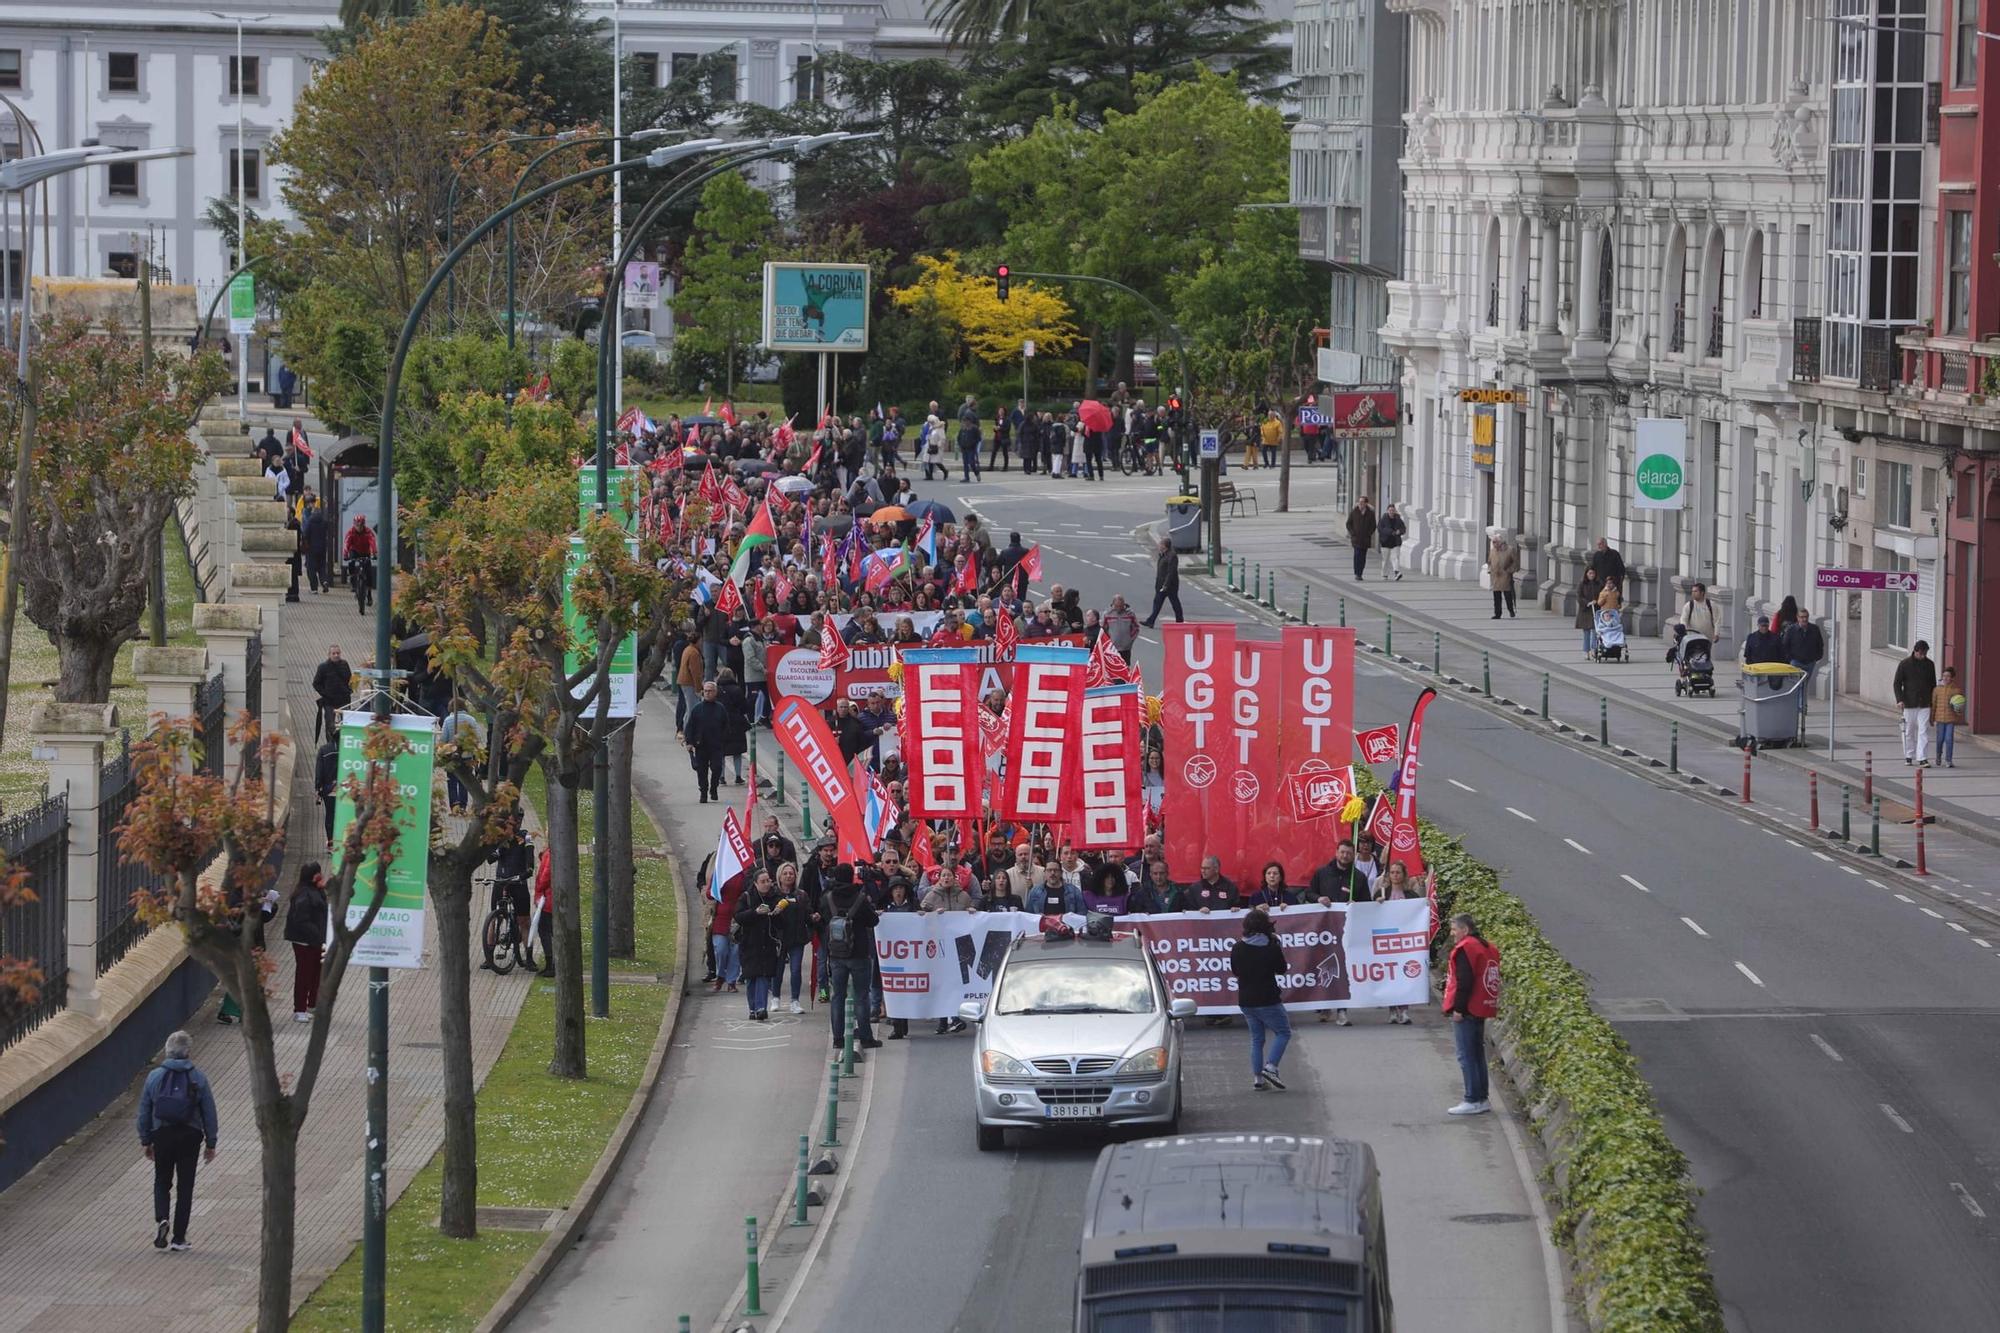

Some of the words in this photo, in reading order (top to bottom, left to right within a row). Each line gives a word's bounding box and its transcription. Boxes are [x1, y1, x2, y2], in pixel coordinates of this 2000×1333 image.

[808, 274, 816, 288] A
[819, 272, 863, 291] CORUÑA
[1461, 389, 1513, 403] POMBO
[581, 475, 593, 484] En
[1818, 575, 1839, 583] UDC
[1843, 575, 1860, 584] Oza
[1184, 633, 1215, 749] UGT
[1302, 638, 1333, 753] UGT
[1233, 650, 1261, 764] UGT
[343, 735, 362, 748] En
[918, 664, 966, 811] CCOO
[1016, 664, 1071, 814] CCOO
[1368, 736, 1389, 753] UGT
[787, 713, 846, 805] CCOO
[1081, 696, 1128, 844] CCOO
[1310, 780, 1342, 799] UGT
[378, 911, 410, 922] MAIO
[877, 940, 923, 959] UGT
[1376, 934, 1426, 951] CCOO
[1195, 957, 1232, 972] XOR
[1352, 961, 1399, 983] UGT
[881, 976, 928, 989] CCOO
[1053, 1106, 1079, 1116] 3818
